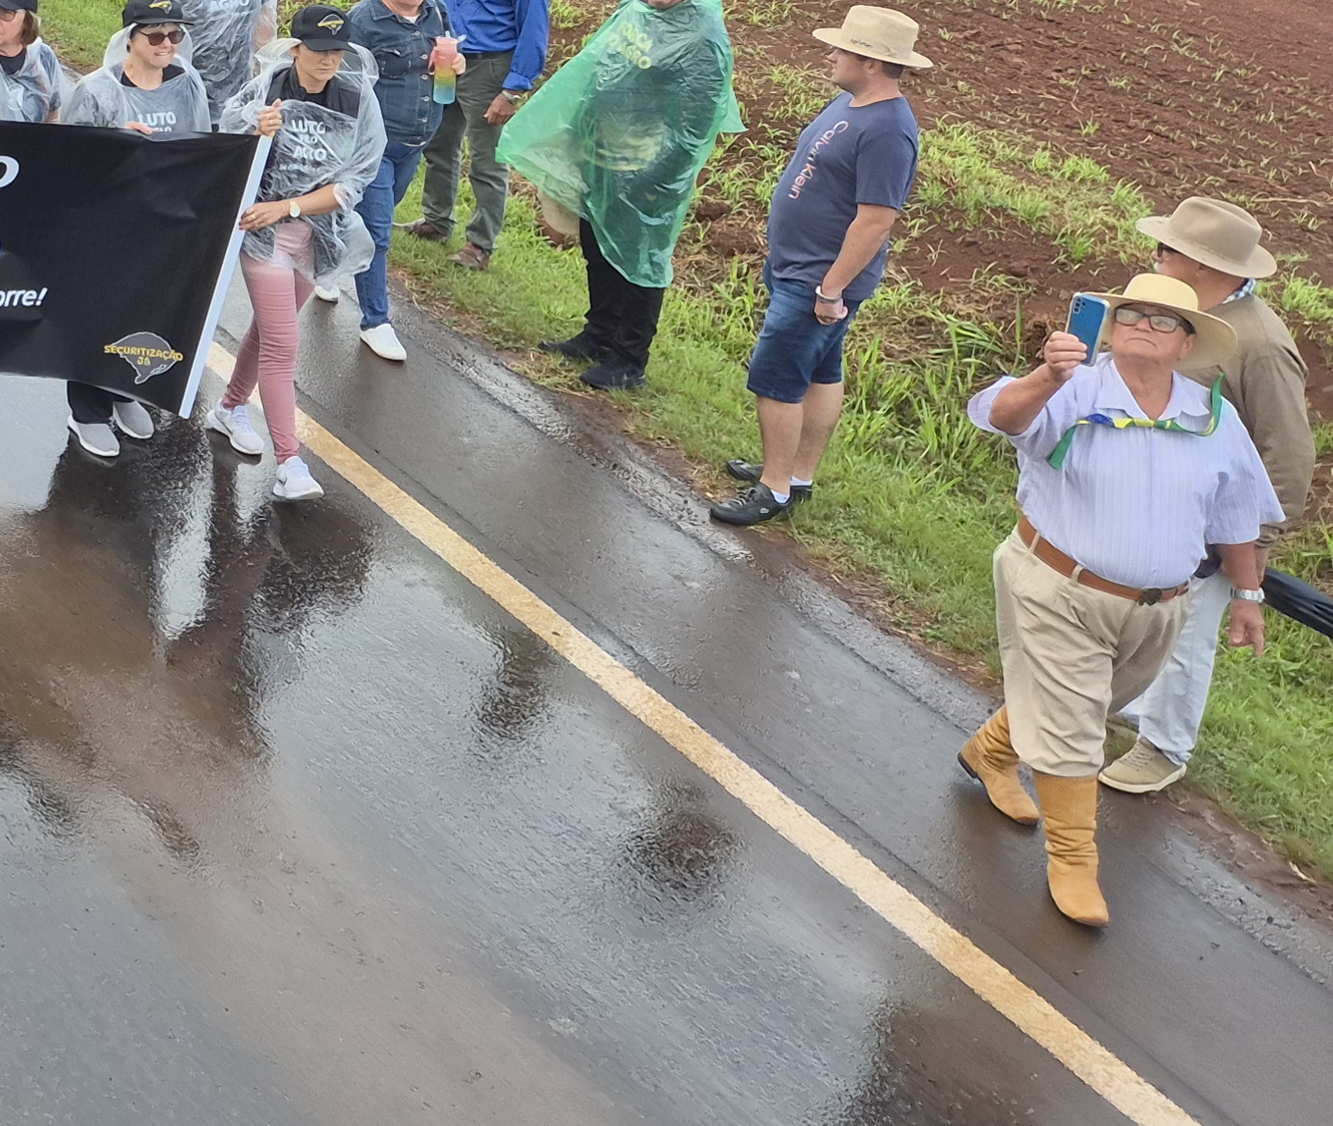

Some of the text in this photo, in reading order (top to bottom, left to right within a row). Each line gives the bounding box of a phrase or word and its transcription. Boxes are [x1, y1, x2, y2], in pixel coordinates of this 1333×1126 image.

[138, 111, 177, 127] LUTO
[788, 120, 850, 200] Calvin Klein
[103, 344, 184, 362] SECURITIZAÇÃO
